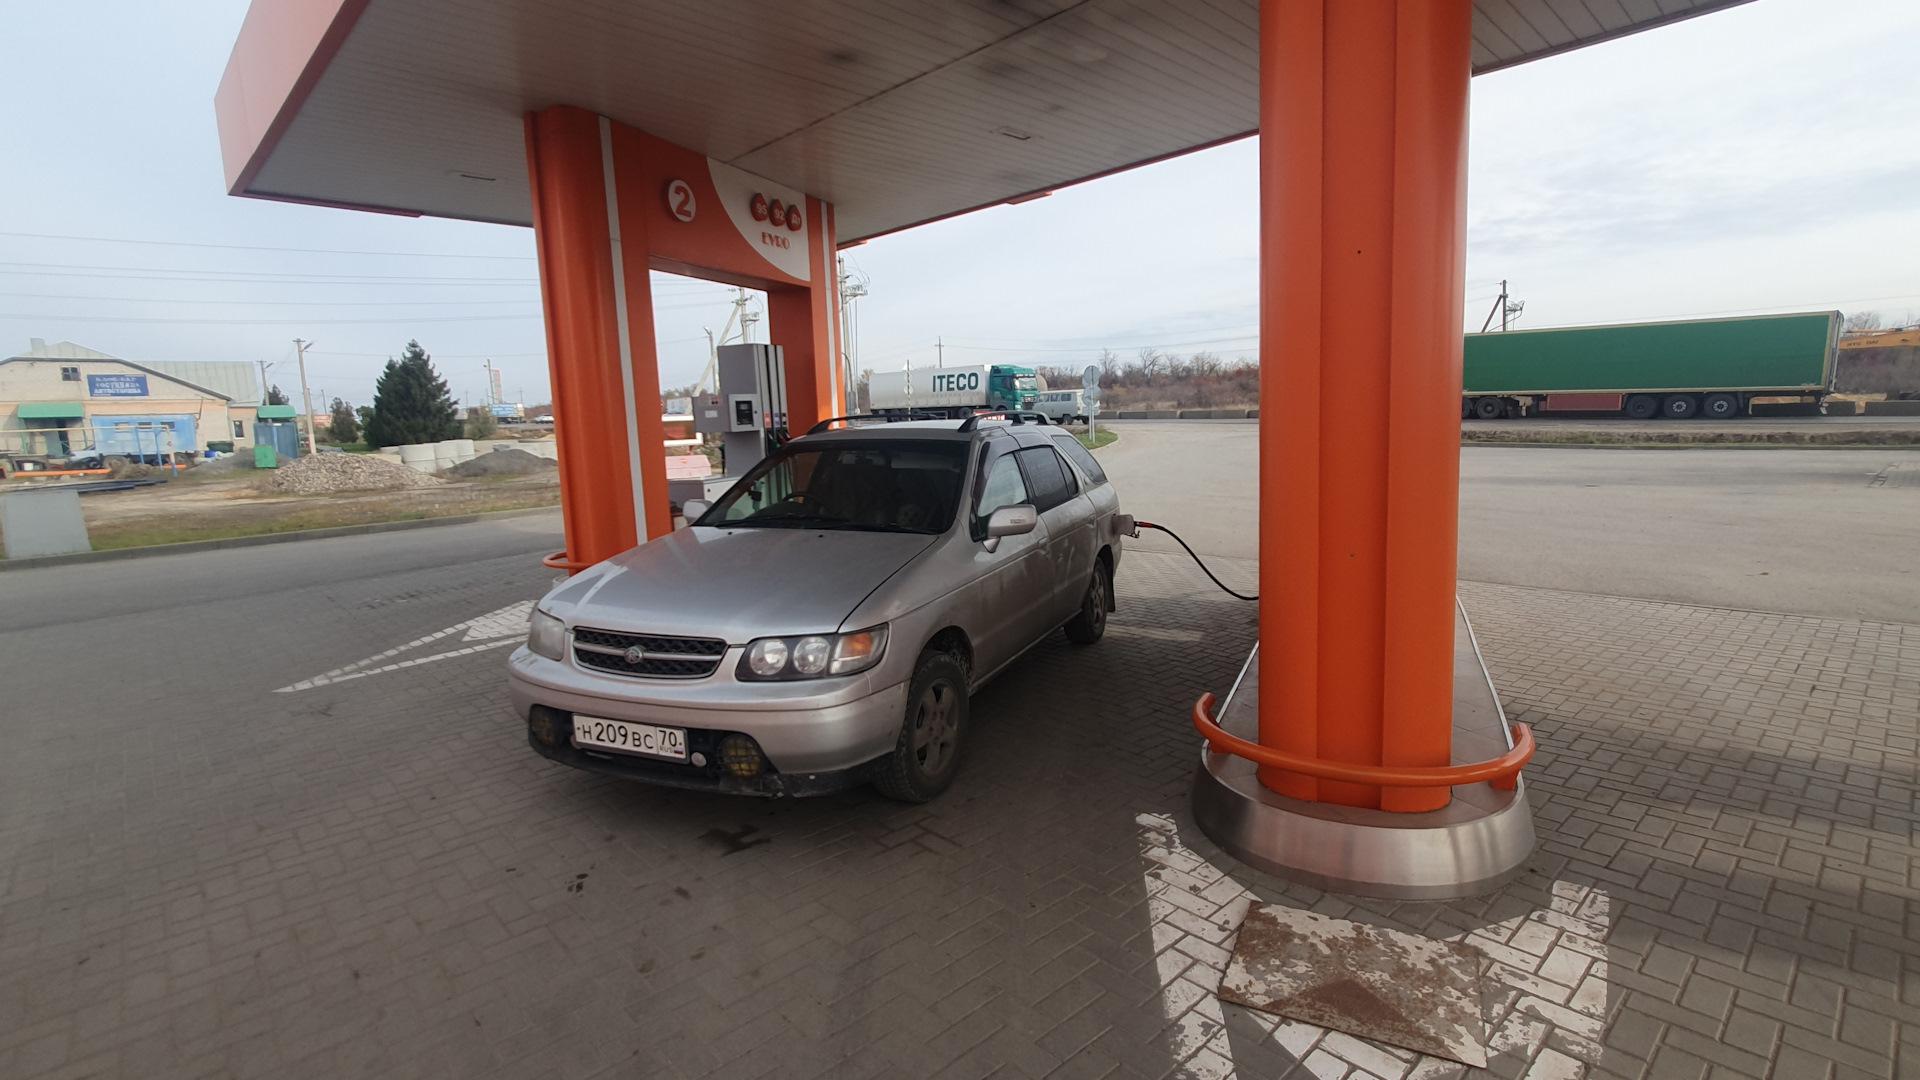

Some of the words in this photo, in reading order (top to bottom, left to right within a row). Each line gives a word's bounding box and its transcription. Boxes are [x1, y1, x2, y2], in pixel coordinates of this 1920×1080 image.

[674, 186, 692, 217] 2
[932, 372, 979, 393] ITECO
[658, 729, 678, 747] 70
